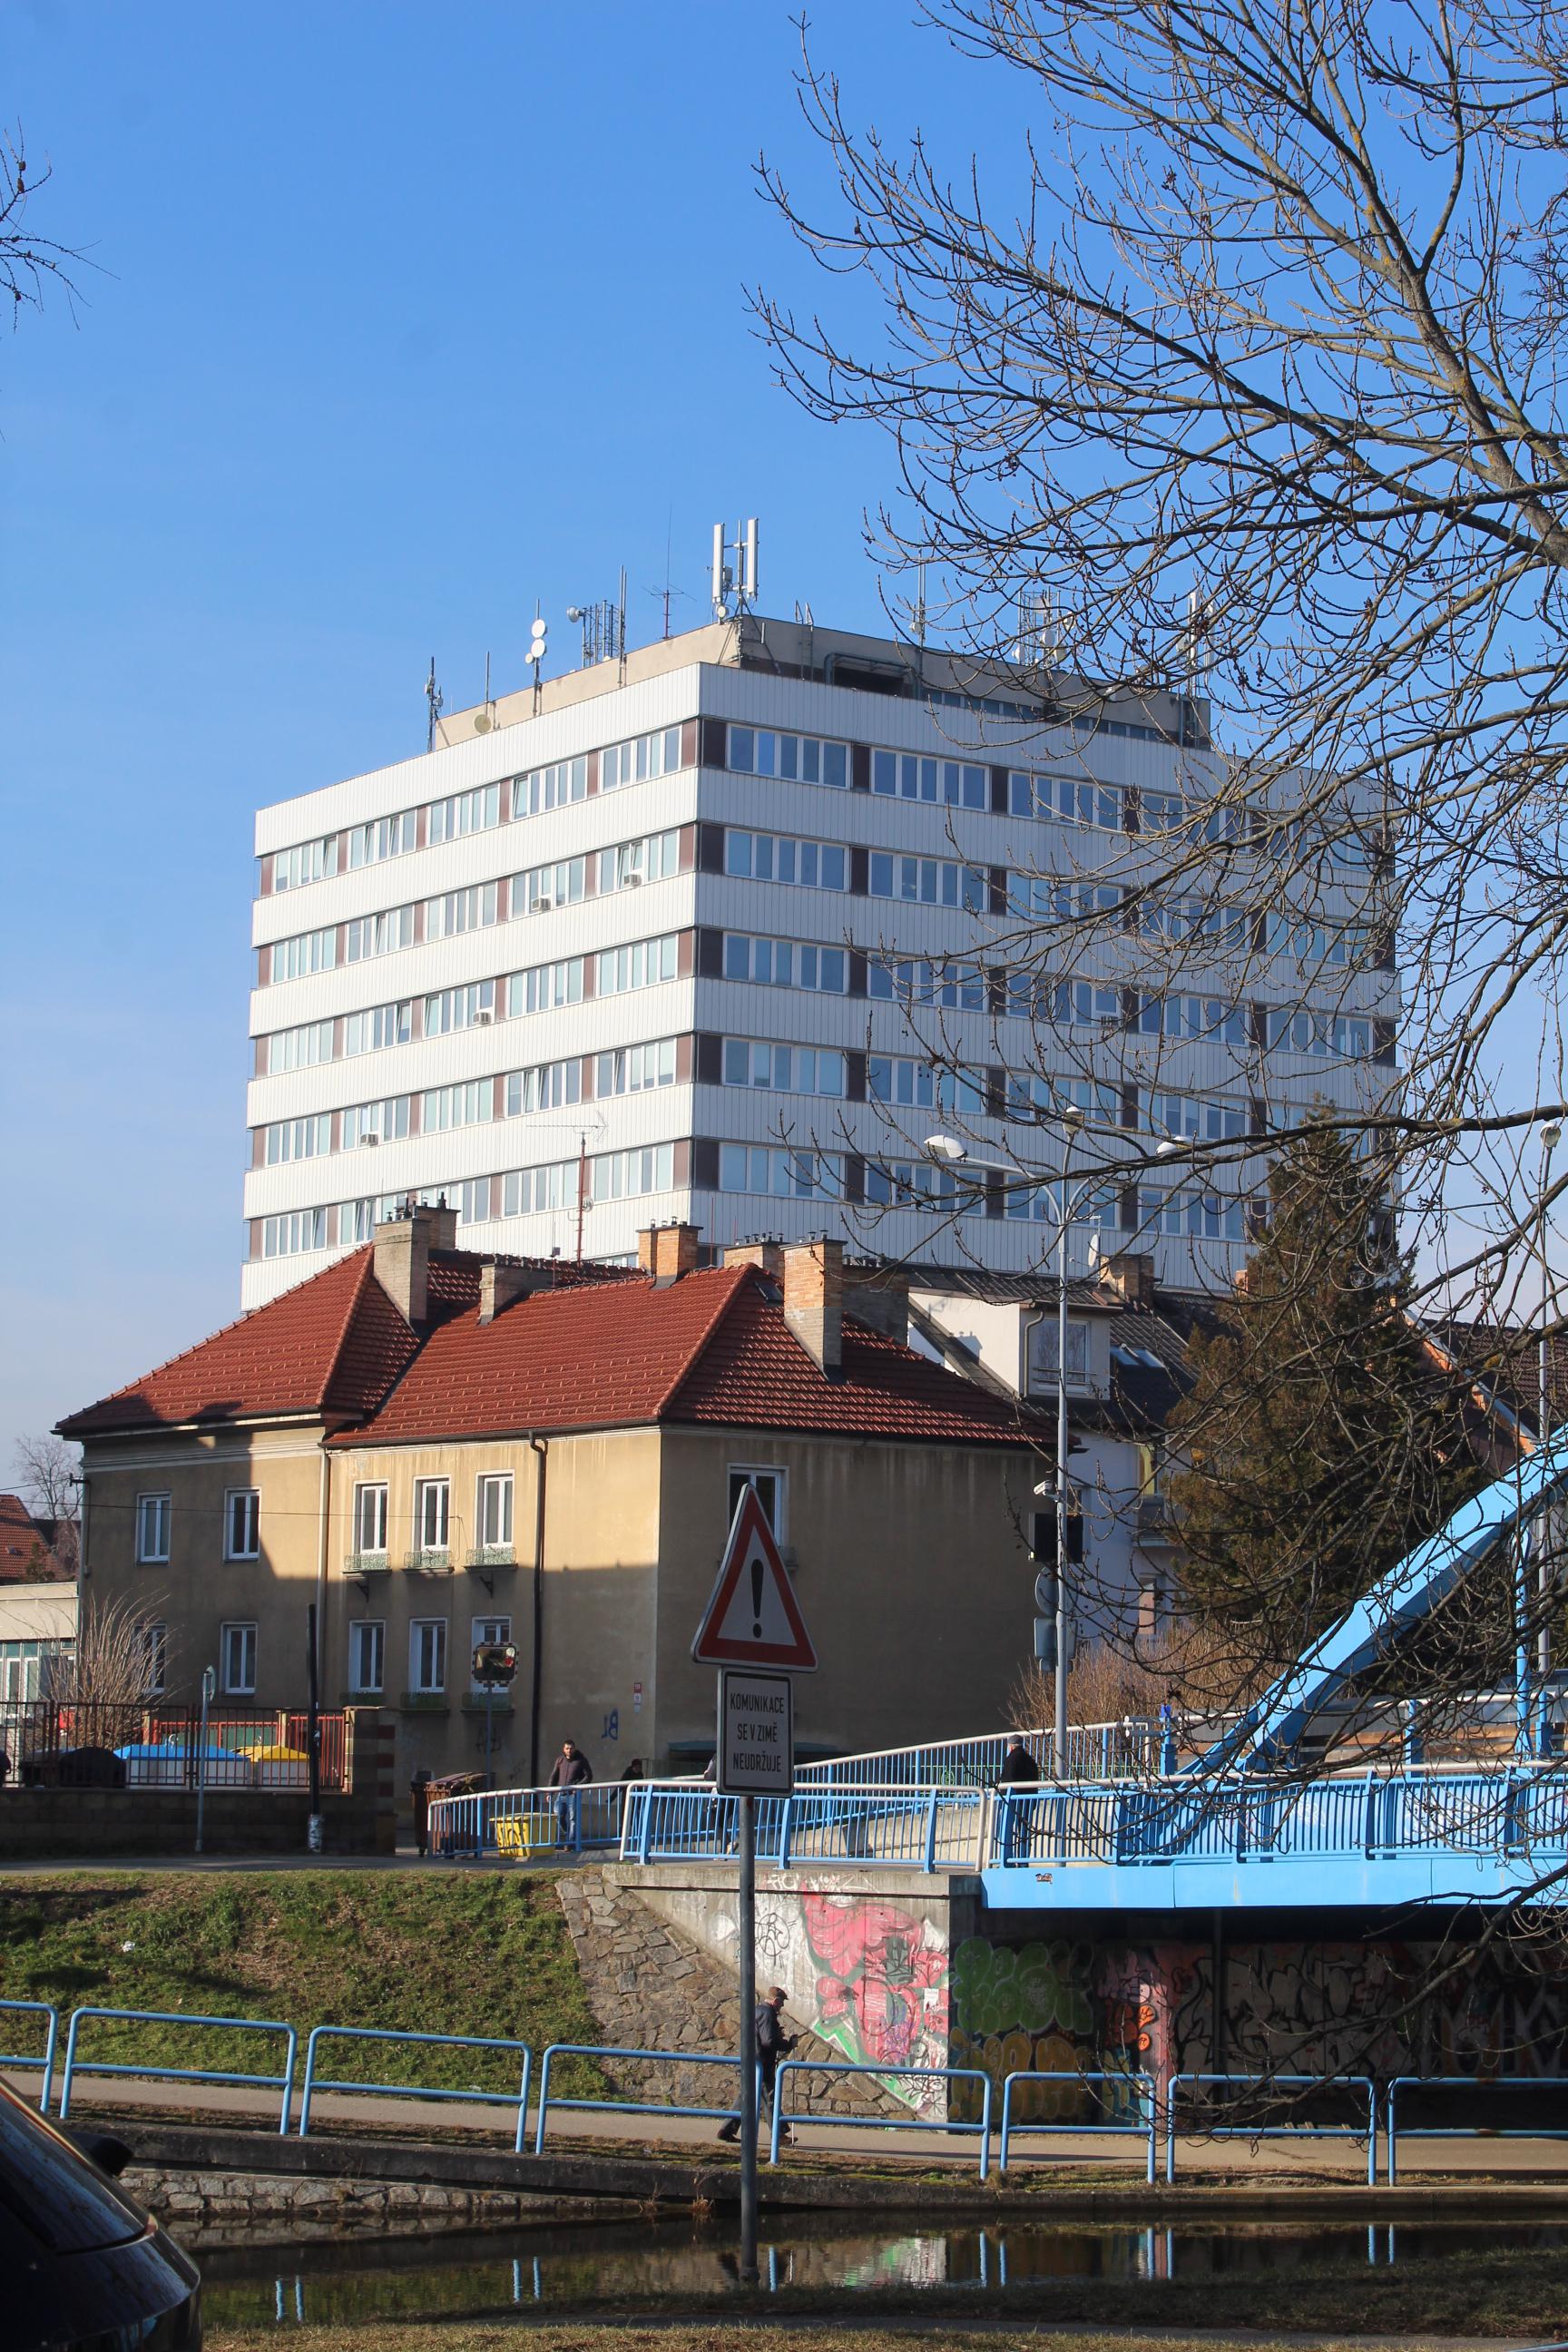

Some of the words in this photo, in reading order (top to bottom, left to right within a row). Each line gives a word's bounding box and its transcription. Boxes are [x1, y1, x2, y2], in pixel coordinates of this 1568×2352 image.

[730, 1692, 785, 1713] KOMUNIKACE
[737, 1723, 748, 1741] SE
[750, 1724, 756, 1741] V
[757, 1721, 778, 1742] ZIMĚ
[733, 1750, 782, 1772] NEUDRŽUJE
